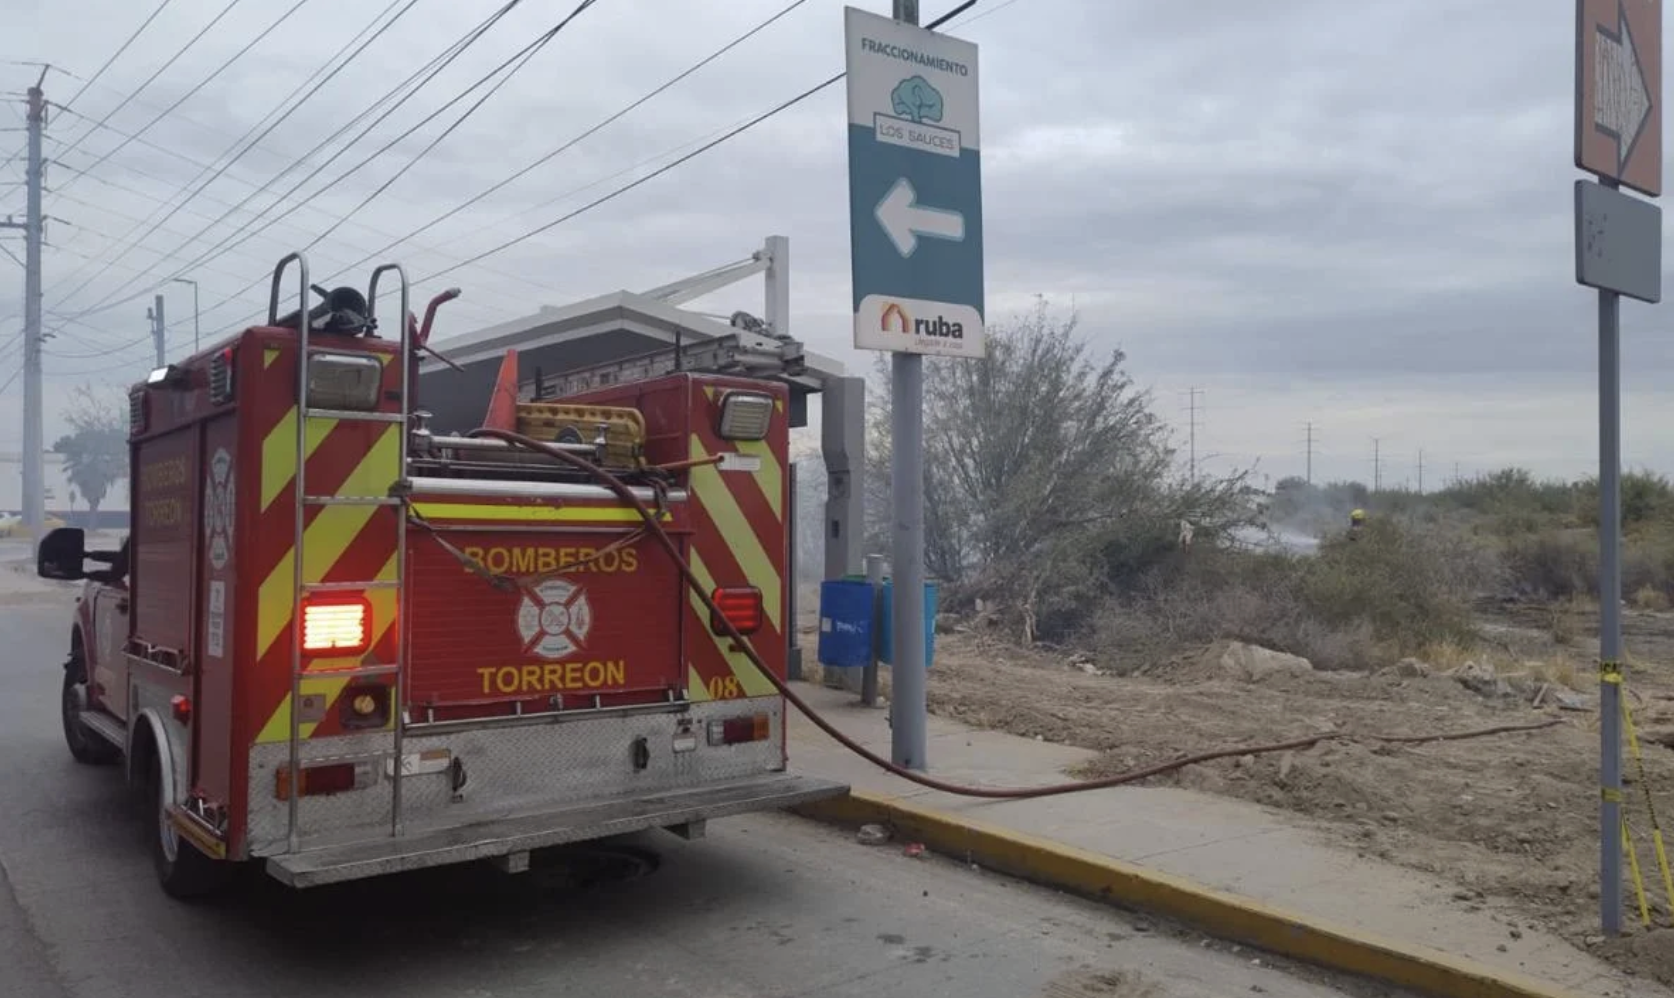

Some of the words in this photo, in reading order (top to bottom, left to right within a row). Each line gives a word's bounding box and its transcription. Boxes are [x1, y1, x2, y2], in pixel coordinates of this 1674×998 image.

[861, 37, 969, 77] FRACCIONAMIENTO
[879, 122, 904, 139] LOS
[908, 130, 956, 150] SAUCES
[914, 315, 963, 339] ruba
[463, 546, 638, 574] BOMBEROS
[477, 660, 626, 694] TORREON
[710, 675, 739, 700] 08
